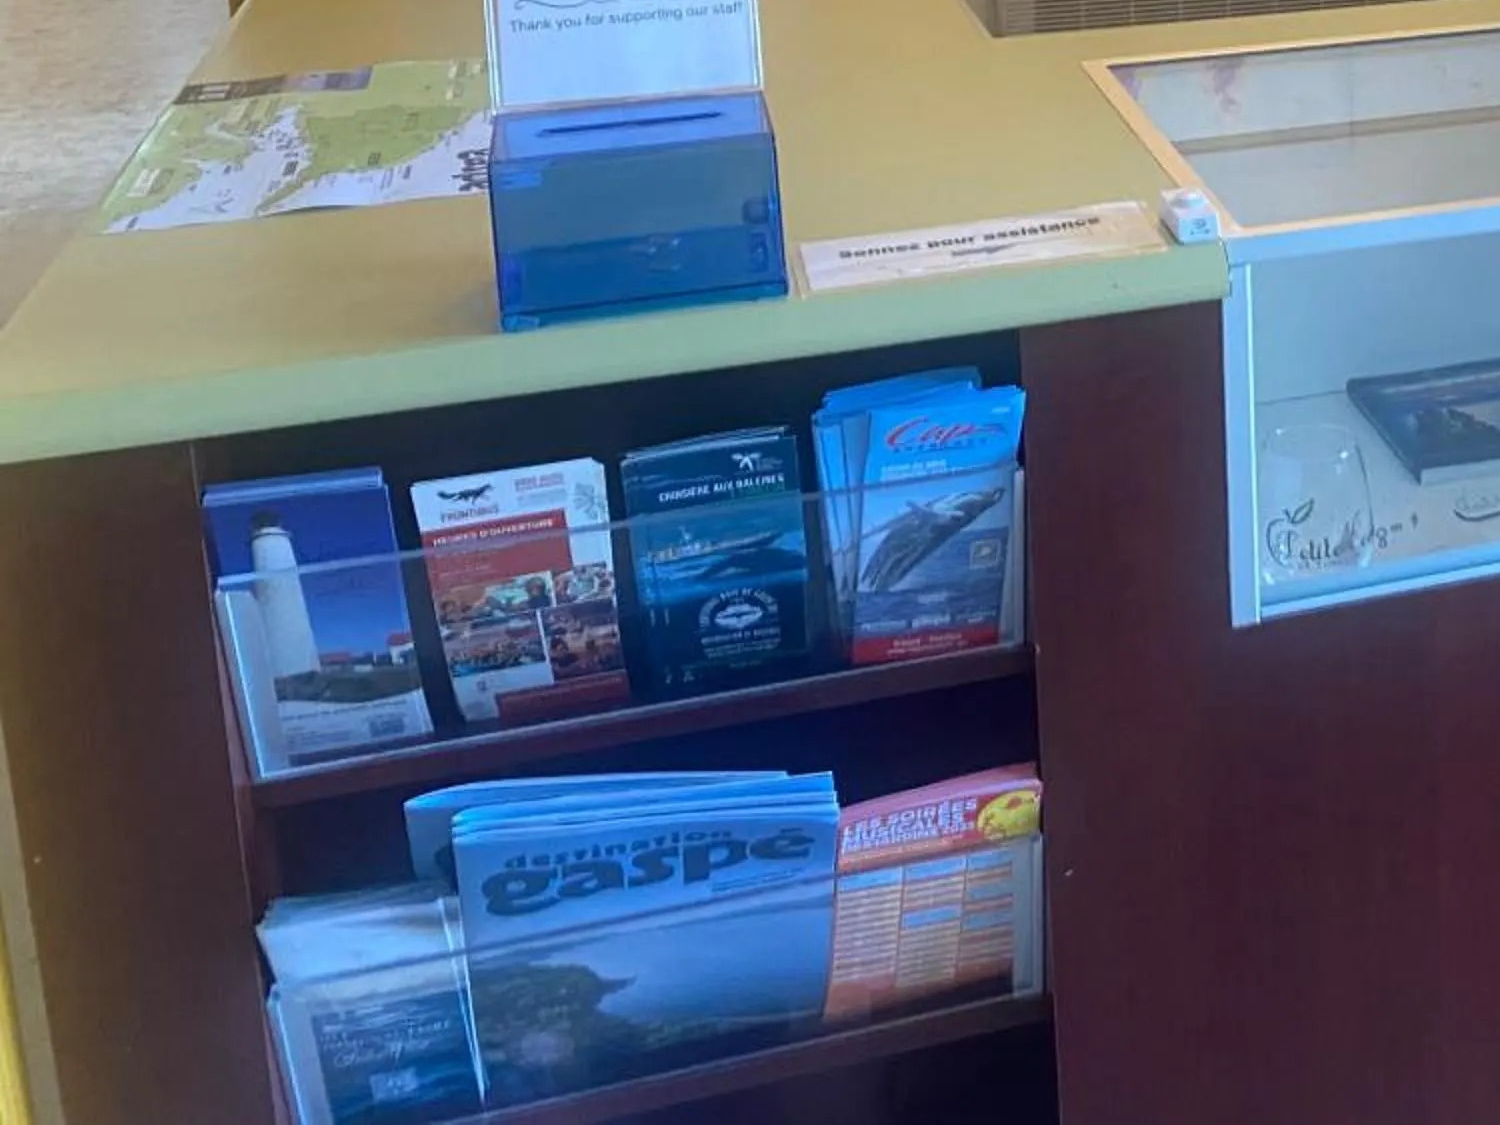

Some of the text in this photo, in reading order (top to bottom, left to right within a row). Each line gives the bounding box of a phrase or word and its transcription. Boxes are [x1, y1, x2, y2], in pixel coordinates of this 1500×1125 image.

[509, 0, 744, 34] Thank you for supporting our staff
[983, 216, 1101, 243] assistance
[481, 826, 816, 916] gaspé
